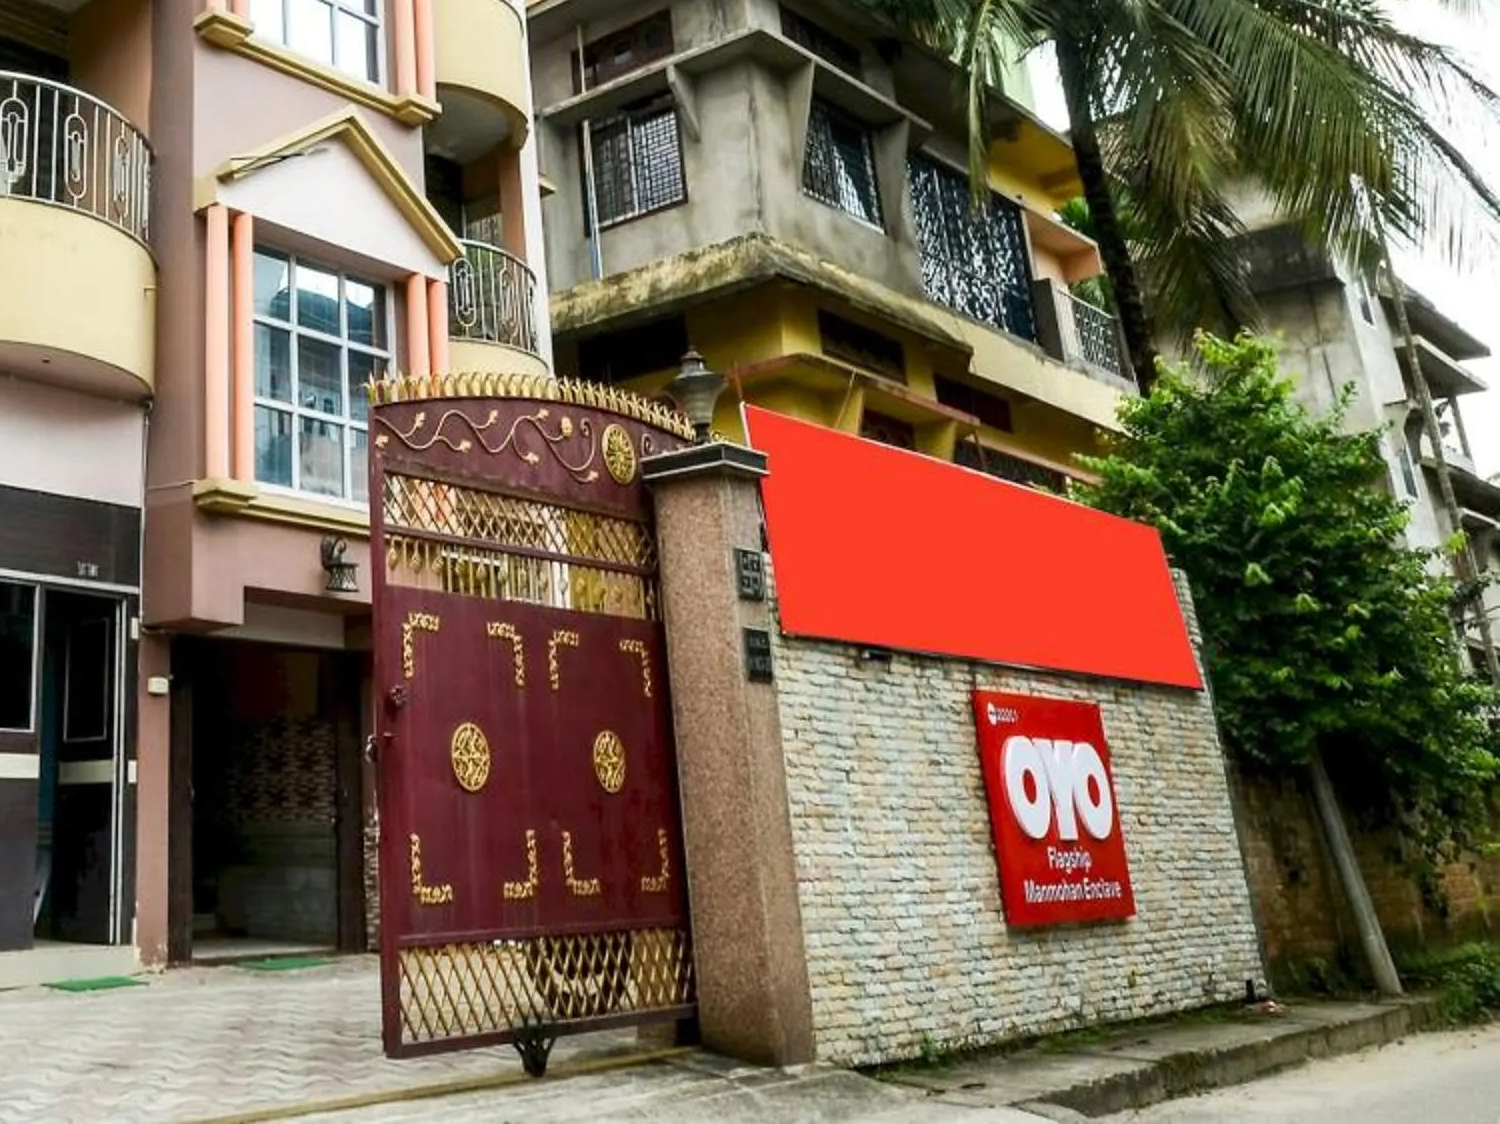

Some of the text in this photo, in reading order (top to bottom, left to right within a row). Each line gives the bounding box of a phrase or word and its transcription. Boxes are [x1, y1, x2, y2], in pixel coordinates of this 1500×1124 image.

[1002, 736, 1112, 840] OYO
[1047, 845, 1091, 874] Flagship
[1024, 877, 1121, 903] Manmohan Enclave
